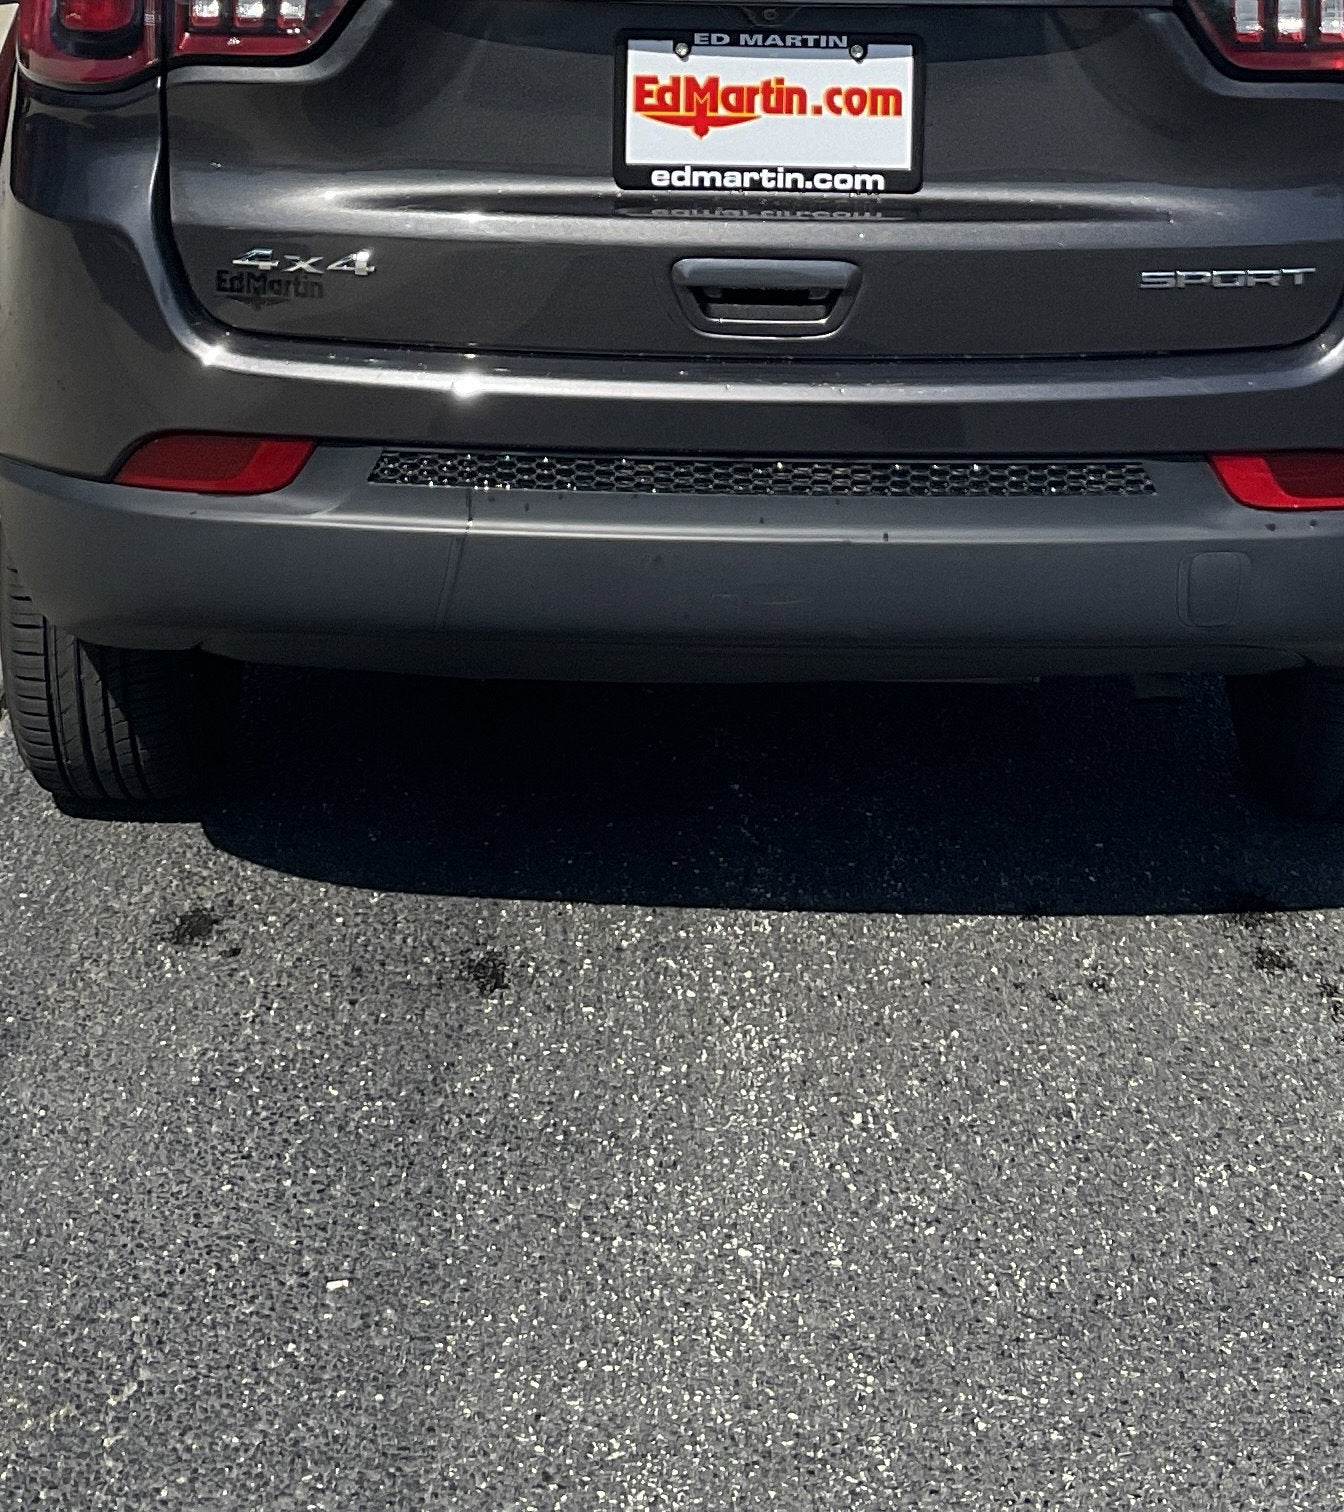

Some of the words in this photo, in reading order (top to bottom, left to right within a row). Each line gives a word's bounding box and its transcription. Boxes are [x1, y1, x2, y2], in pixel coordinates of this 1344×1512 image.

[693, 33, 730, 46] ED
[739, 33, 848, 48] MARTIN
[651, 165, 885, 191] edmartin.com
[215, 270, 324, 300] EdMartin
[1140, 267, 1316, 288] SPORT
